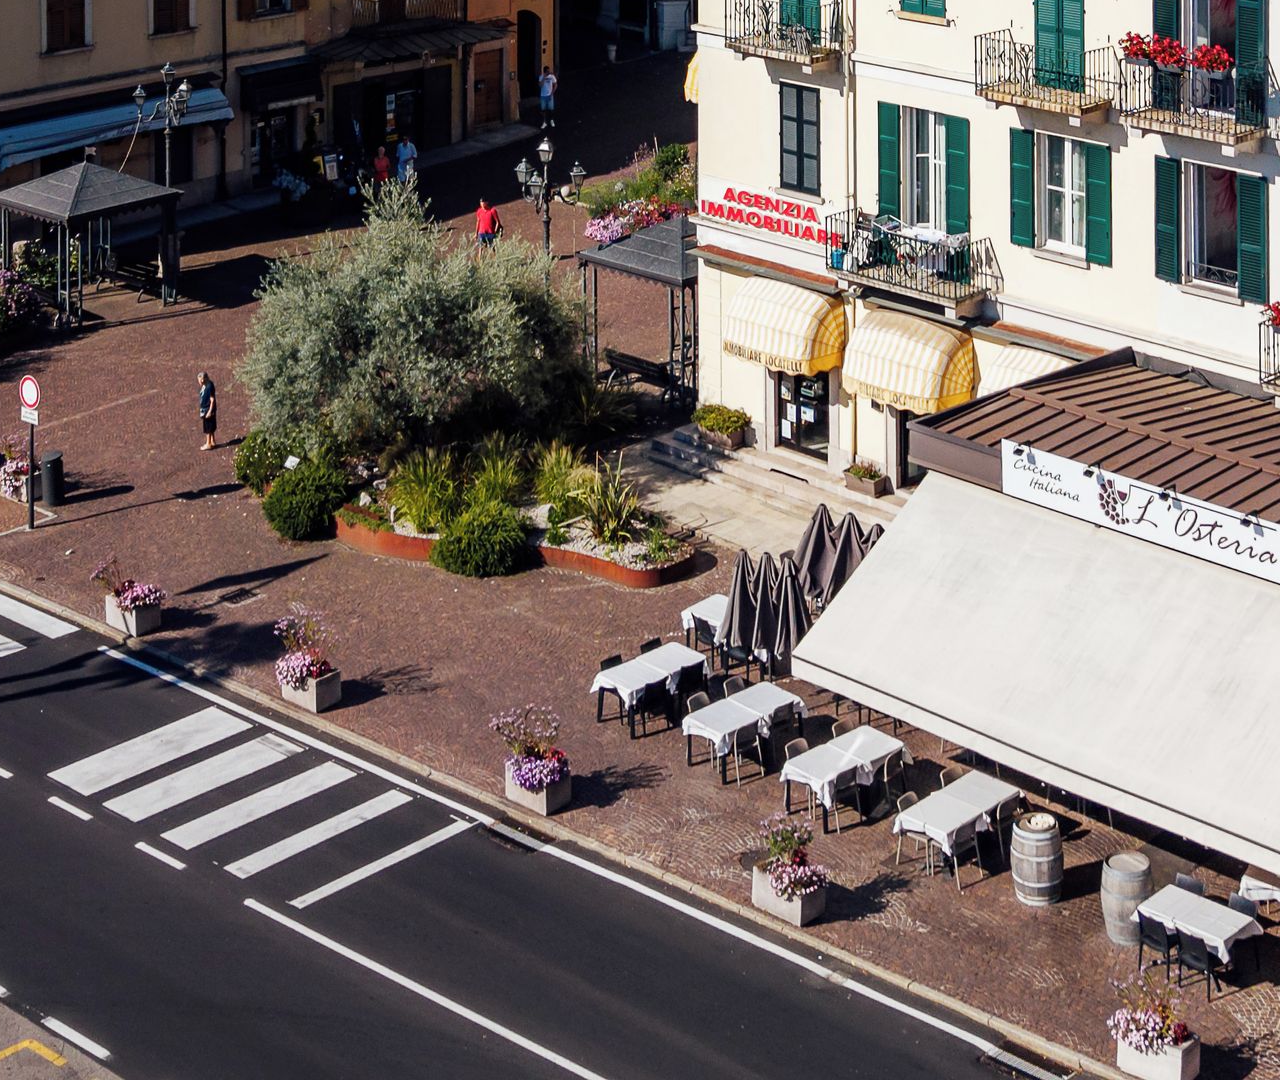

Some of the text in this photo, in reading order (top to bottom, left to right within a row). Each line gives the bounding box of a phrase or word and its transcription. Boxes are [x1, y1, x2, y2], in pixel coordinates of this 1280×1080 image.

[723, 187, 819, 223] AGENZIA
[701, 199, 843, 249] IMMOBILIARE
[765, 354, 803, 372] LOCATELLI
[1013, 458, 1062, 482] Cucina
[1029, 477, 1081, 503] Italiana
